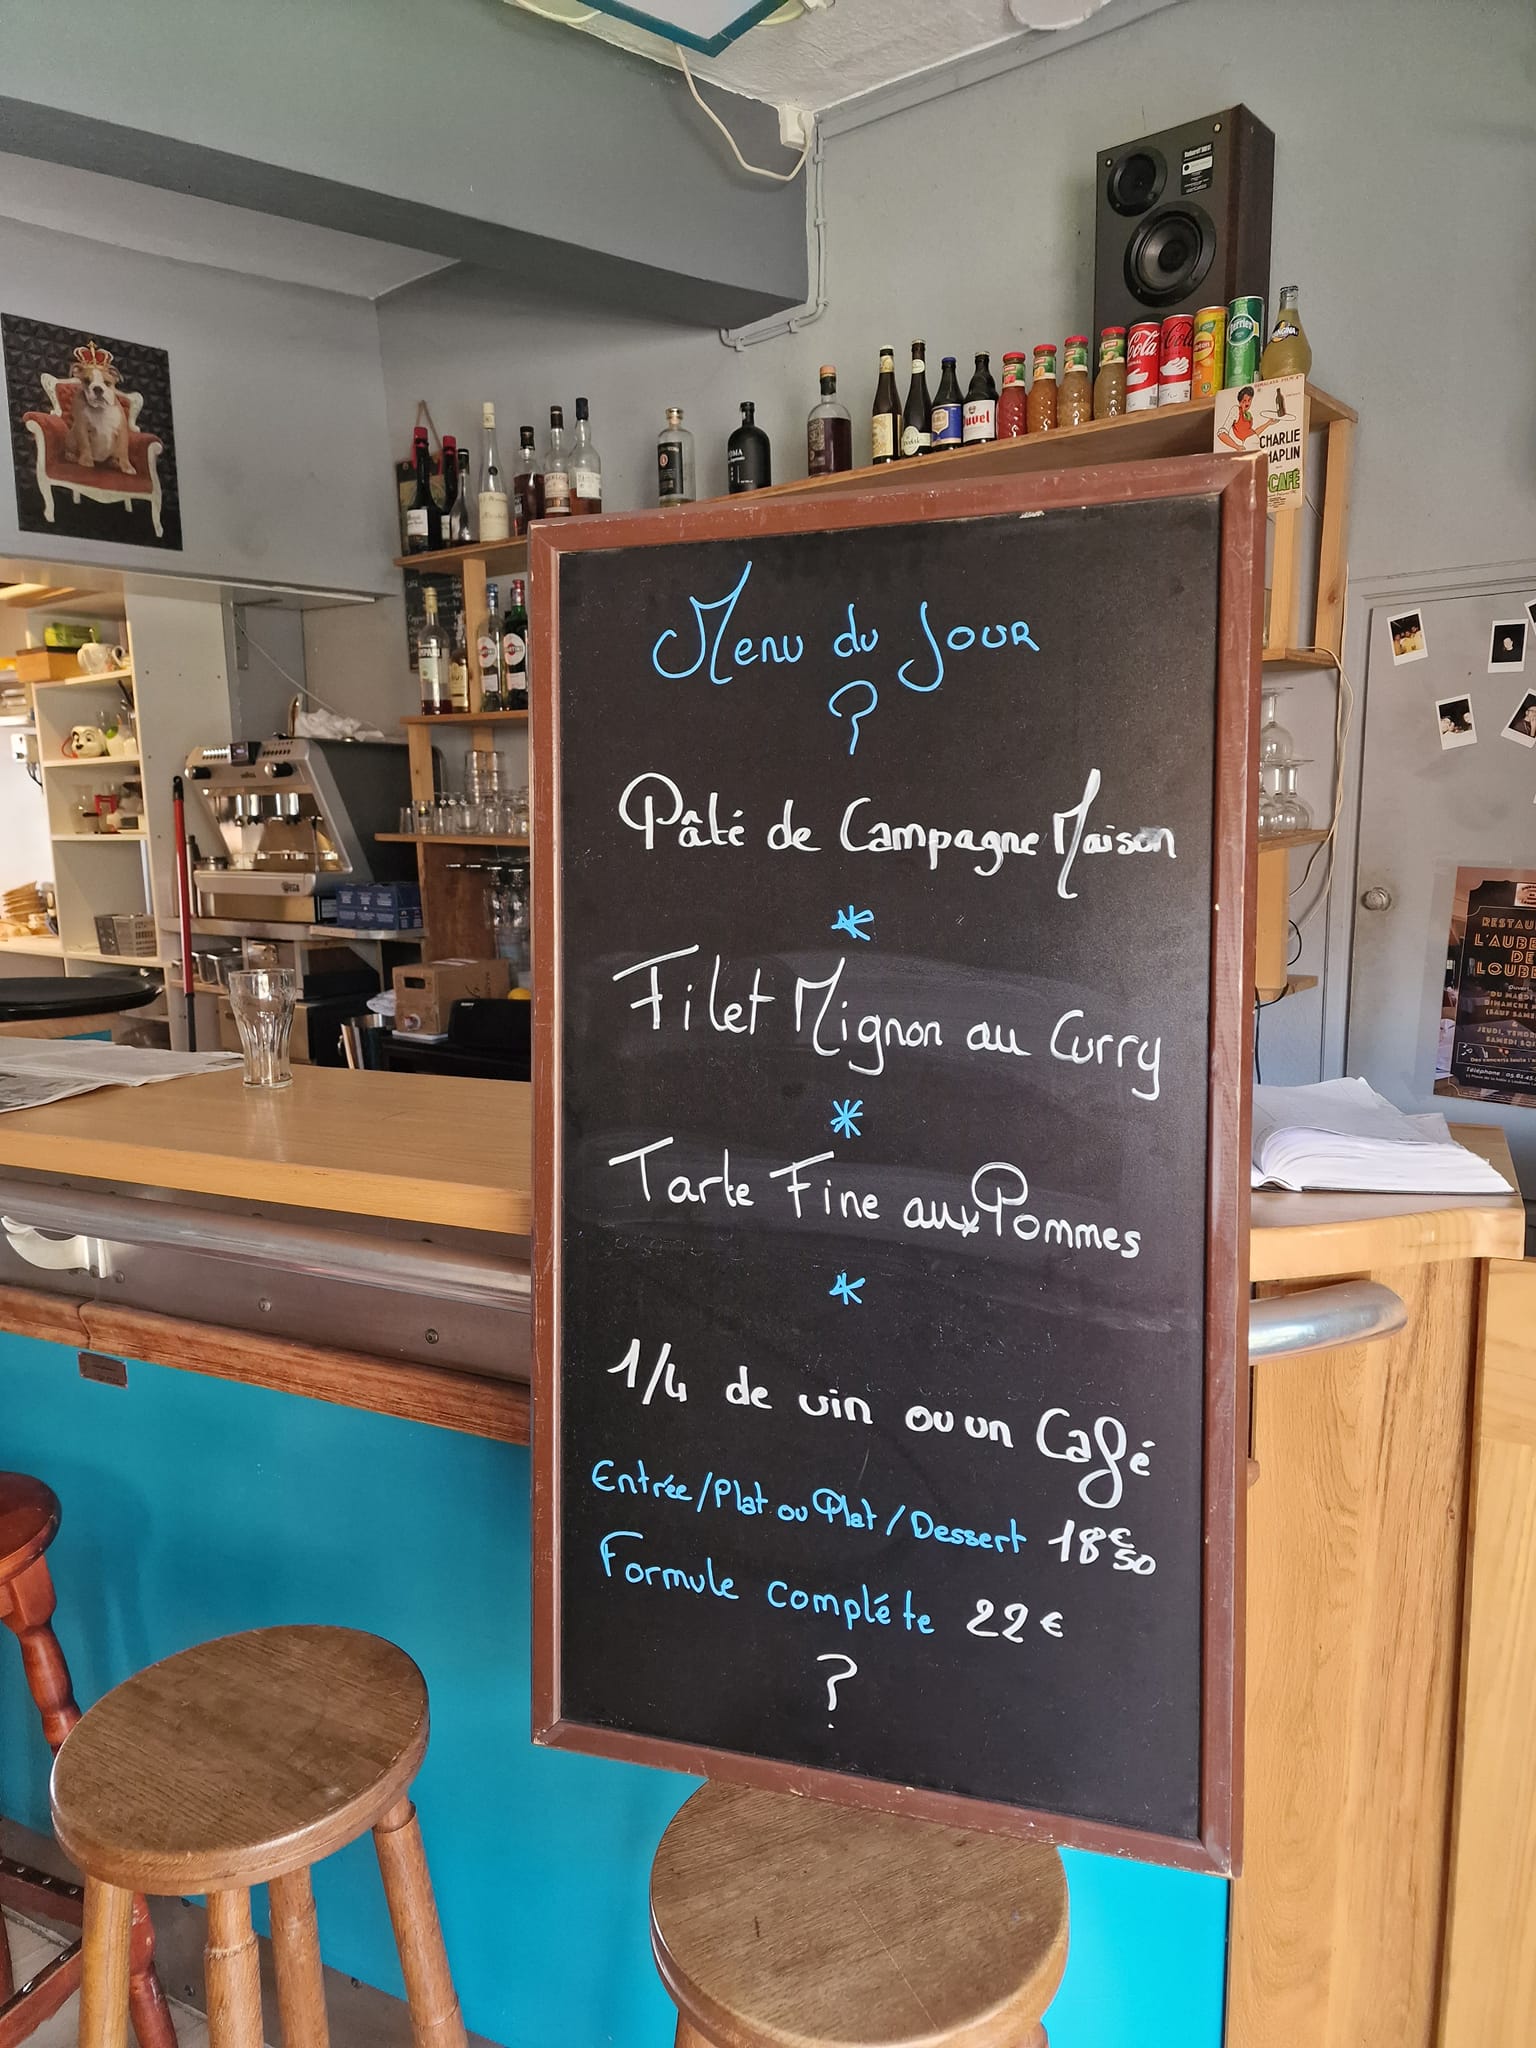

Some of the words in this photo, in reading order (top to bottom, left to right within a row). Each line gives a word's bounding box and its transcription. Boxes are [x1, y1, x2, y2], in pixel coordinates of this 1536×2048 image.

[963, 410, 991, 427] uvel
[1259, 428, 1301, 449] CHARLIE
[1267, 445, 1301, 464] HAPLIN
[1267, 467, 1301, 494] CAFÉ
[653, 561, 804, 685] Menu
[834, 604, 879, 658] du
[618, 772, 745, 850] Pâté
[767, 799, 822, 852] de
[840, 798, 1040, 877] Campagne
[1053, 769, 1178, 900] Maison
[1482, 916, 1536, 930] RESTAU
[1511, 950, 1535, 965] DE
[612, 943, 777, 1036] Filet
[794, 957, 944, 1076] Mignon
[966, 1021, 1033, 1056] au
[1049, 1009, 1163, 1102] Curry
[608, 1137, 755, 1208] Tarte
[769, 1150, 882, 1220] Fine
[903, 1196, 980, 1239] aux
[971, 1161, 1143, 1259] Pommes
[606, 1338, 688, 1405] 1/4
[725, 1365, 773, 1410] de
[798, 1388, 875, 1425] vin
[904, 1405, 954, 1433] ou
[964, 1415, 1014, 1449] un
[1035, 1407, 1157, 1509] Café
[777, 1504, 809, 1523] ou
[599, 1530, 740, 1600] Formule
